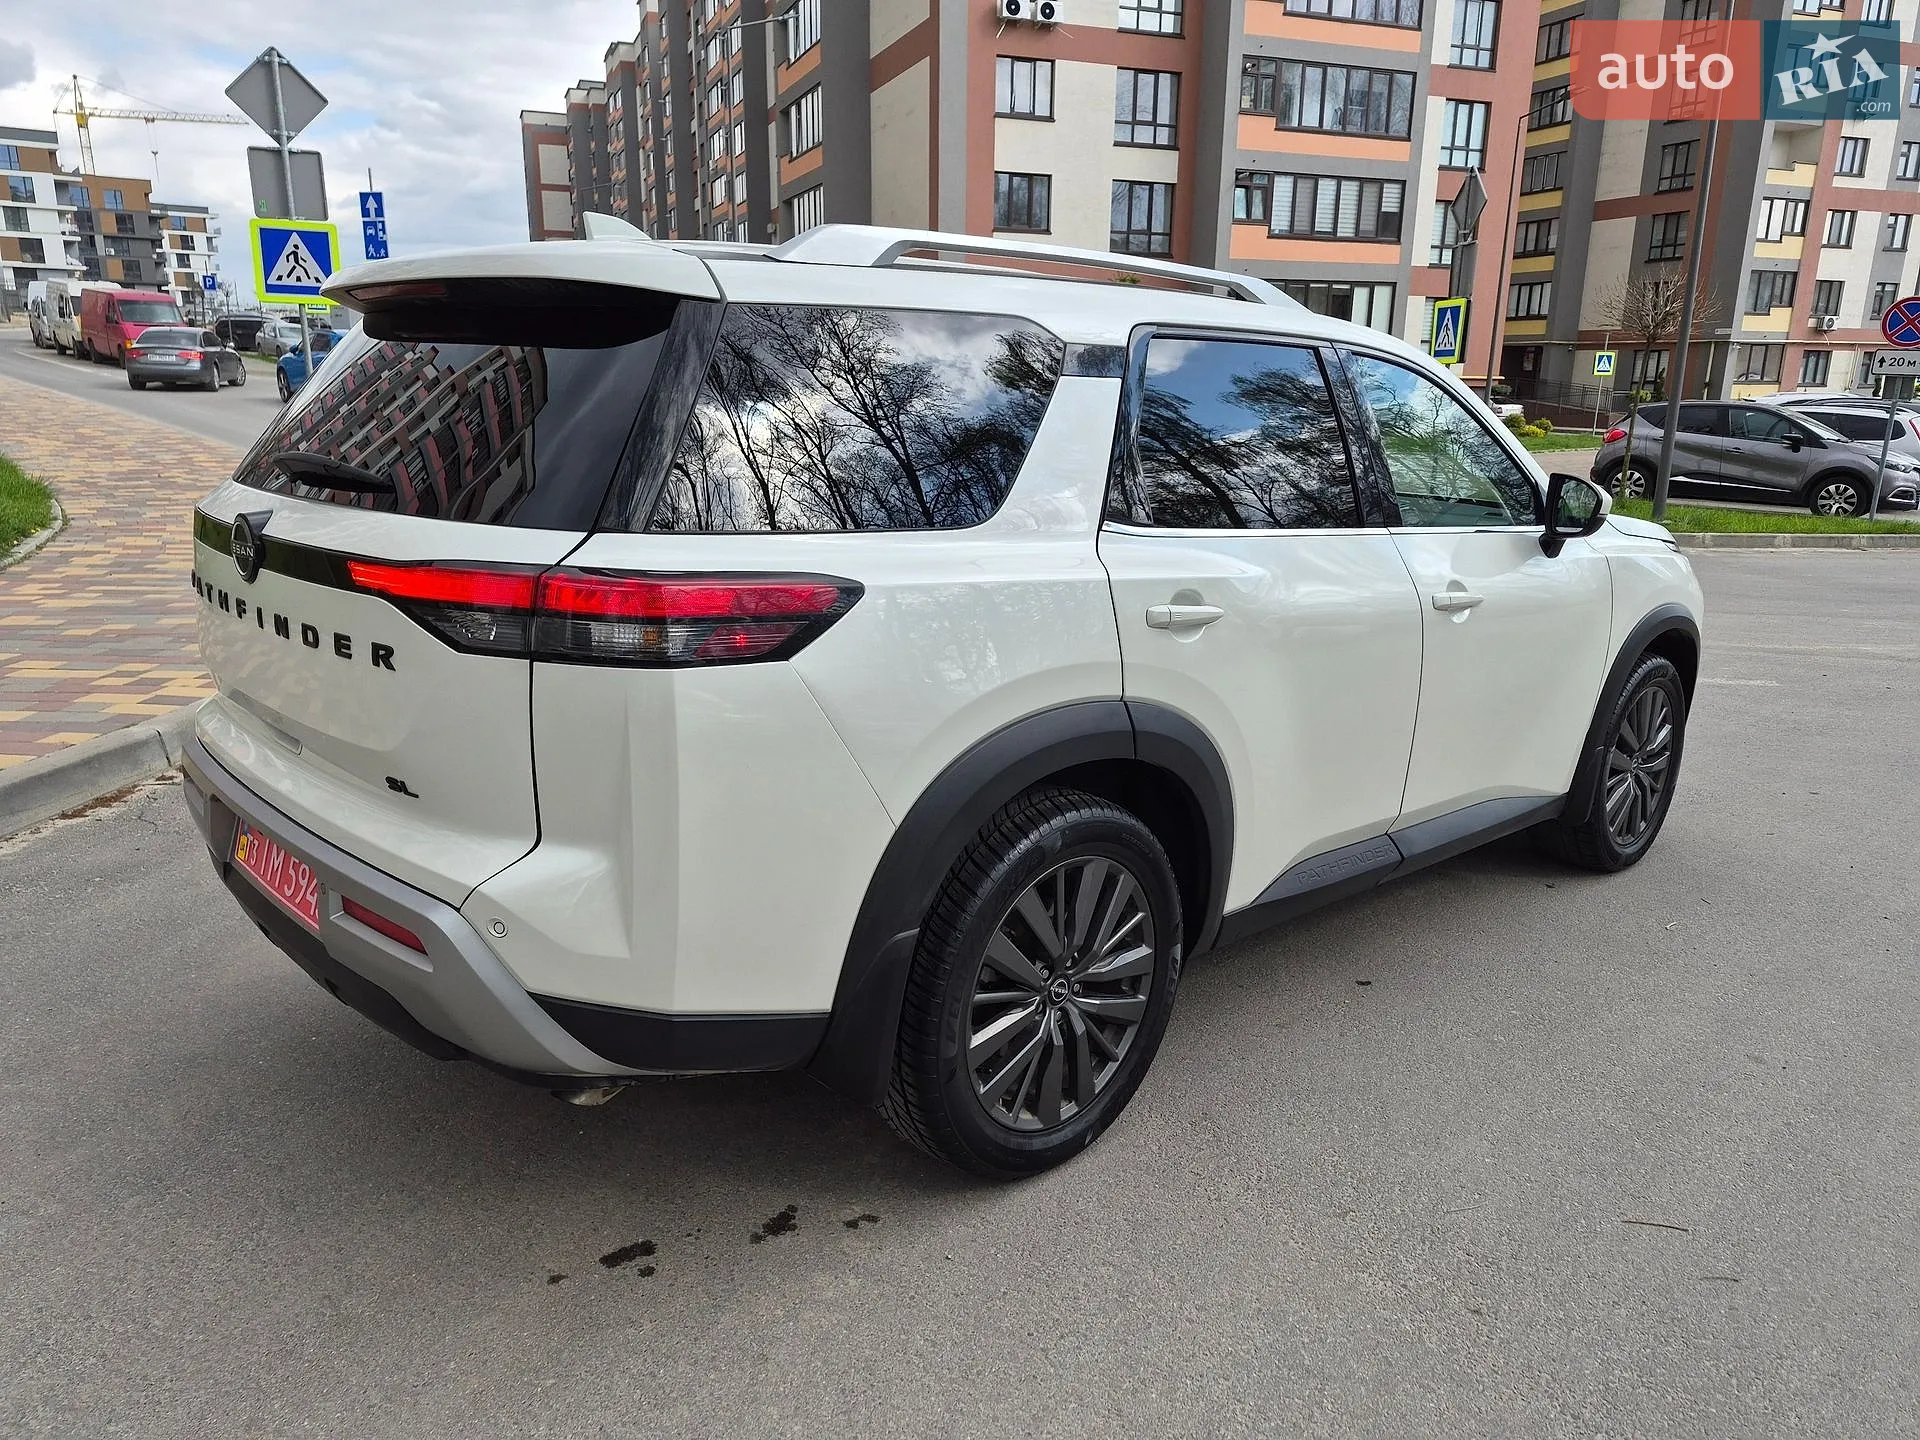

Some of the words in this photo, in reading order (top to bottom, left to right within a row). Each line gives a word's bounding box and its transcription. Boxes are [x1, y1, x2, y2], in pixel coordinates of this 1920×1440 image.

[205, 277, 213, 288] P
[1888, 357, 1906, 367] 20
[385, 776, 420, 798] SL
[1295, 843, 1395, 884] PATHFINDER
[284, 855, 319, 919] 594
